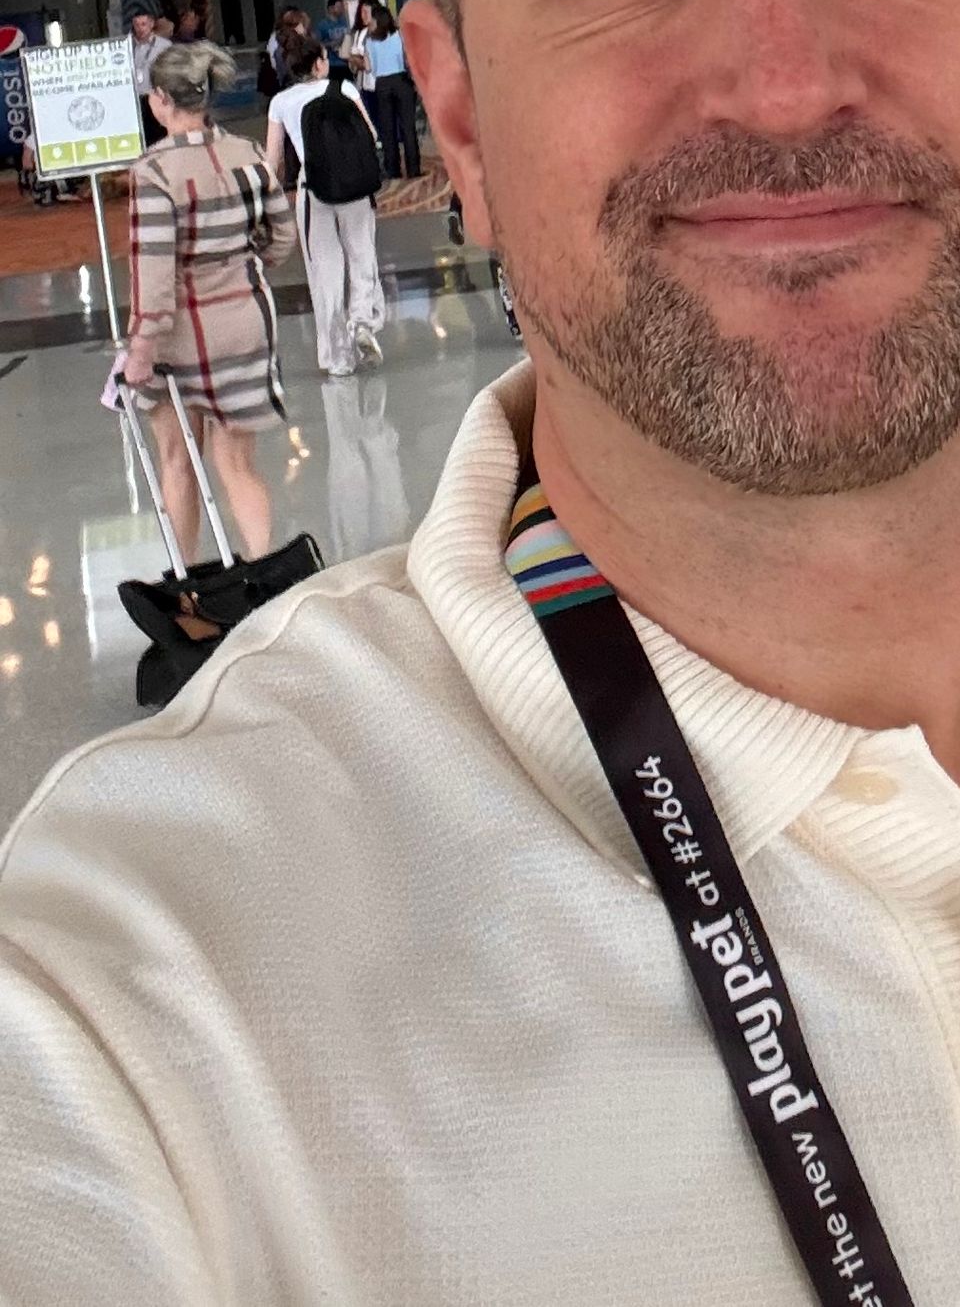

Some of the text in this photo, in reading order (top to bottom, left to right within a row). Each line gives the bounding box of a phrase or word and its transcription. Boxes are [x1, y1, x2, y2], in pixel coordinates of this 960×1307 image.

[635, 755, 703, 864] #2664
[684, 869, 720, 906] at
[734, 906, 764, 966] BRANDS
[689, 912, 819, 1124] playpet
[791, 1132, 838, 1210] new
[826, 1212, 864, 1279] the
